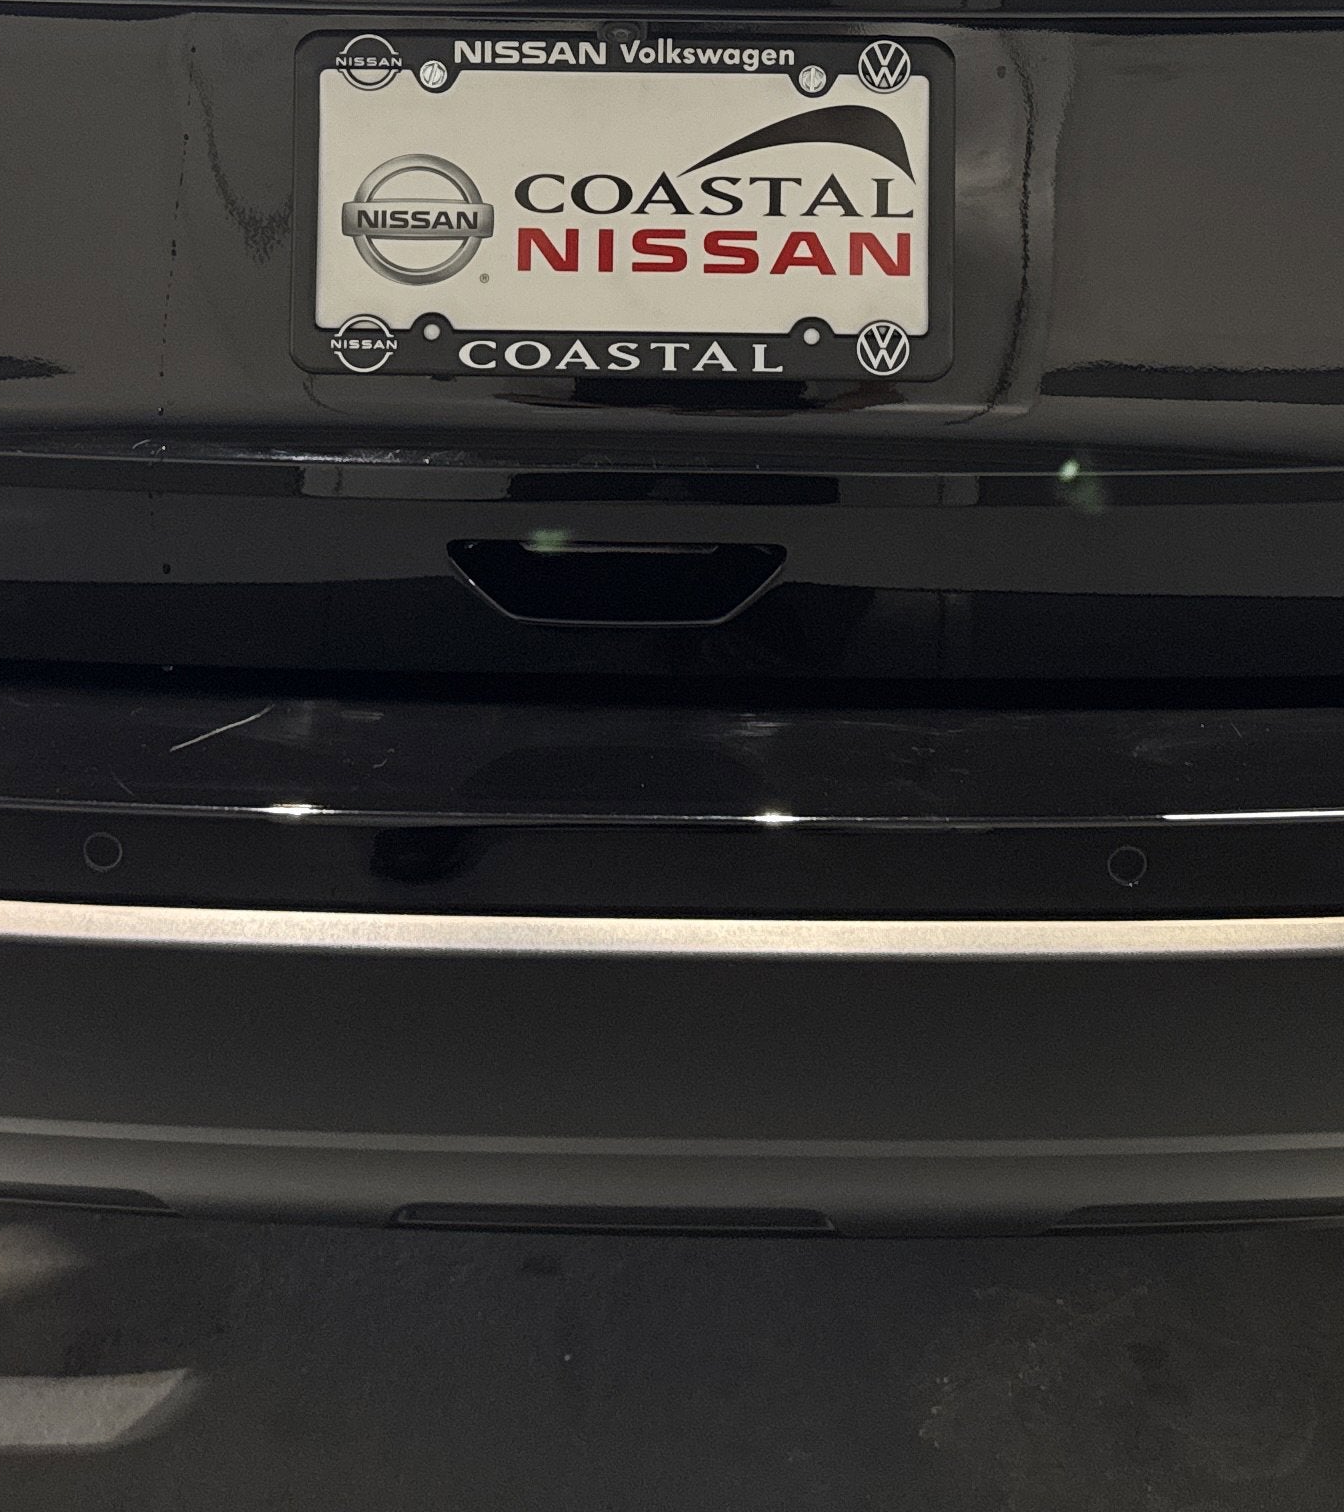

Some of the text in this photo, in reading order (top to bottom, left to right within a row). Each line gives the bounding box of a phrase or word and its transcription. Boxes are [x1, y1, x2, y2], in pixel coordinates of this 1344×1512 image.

[336, 56, 403, 67] NISSAN
[454, 39, 795, 70] NISSAN Volkswagen
[514, 172, 915, 219] COASTAL
[356, 208, 480, 231] NISSAN
[516, 228, 911, 277] NISSAN
[330, 339, 398, 350] NISSAN
[458, 339, 784, 373] COASTAL
